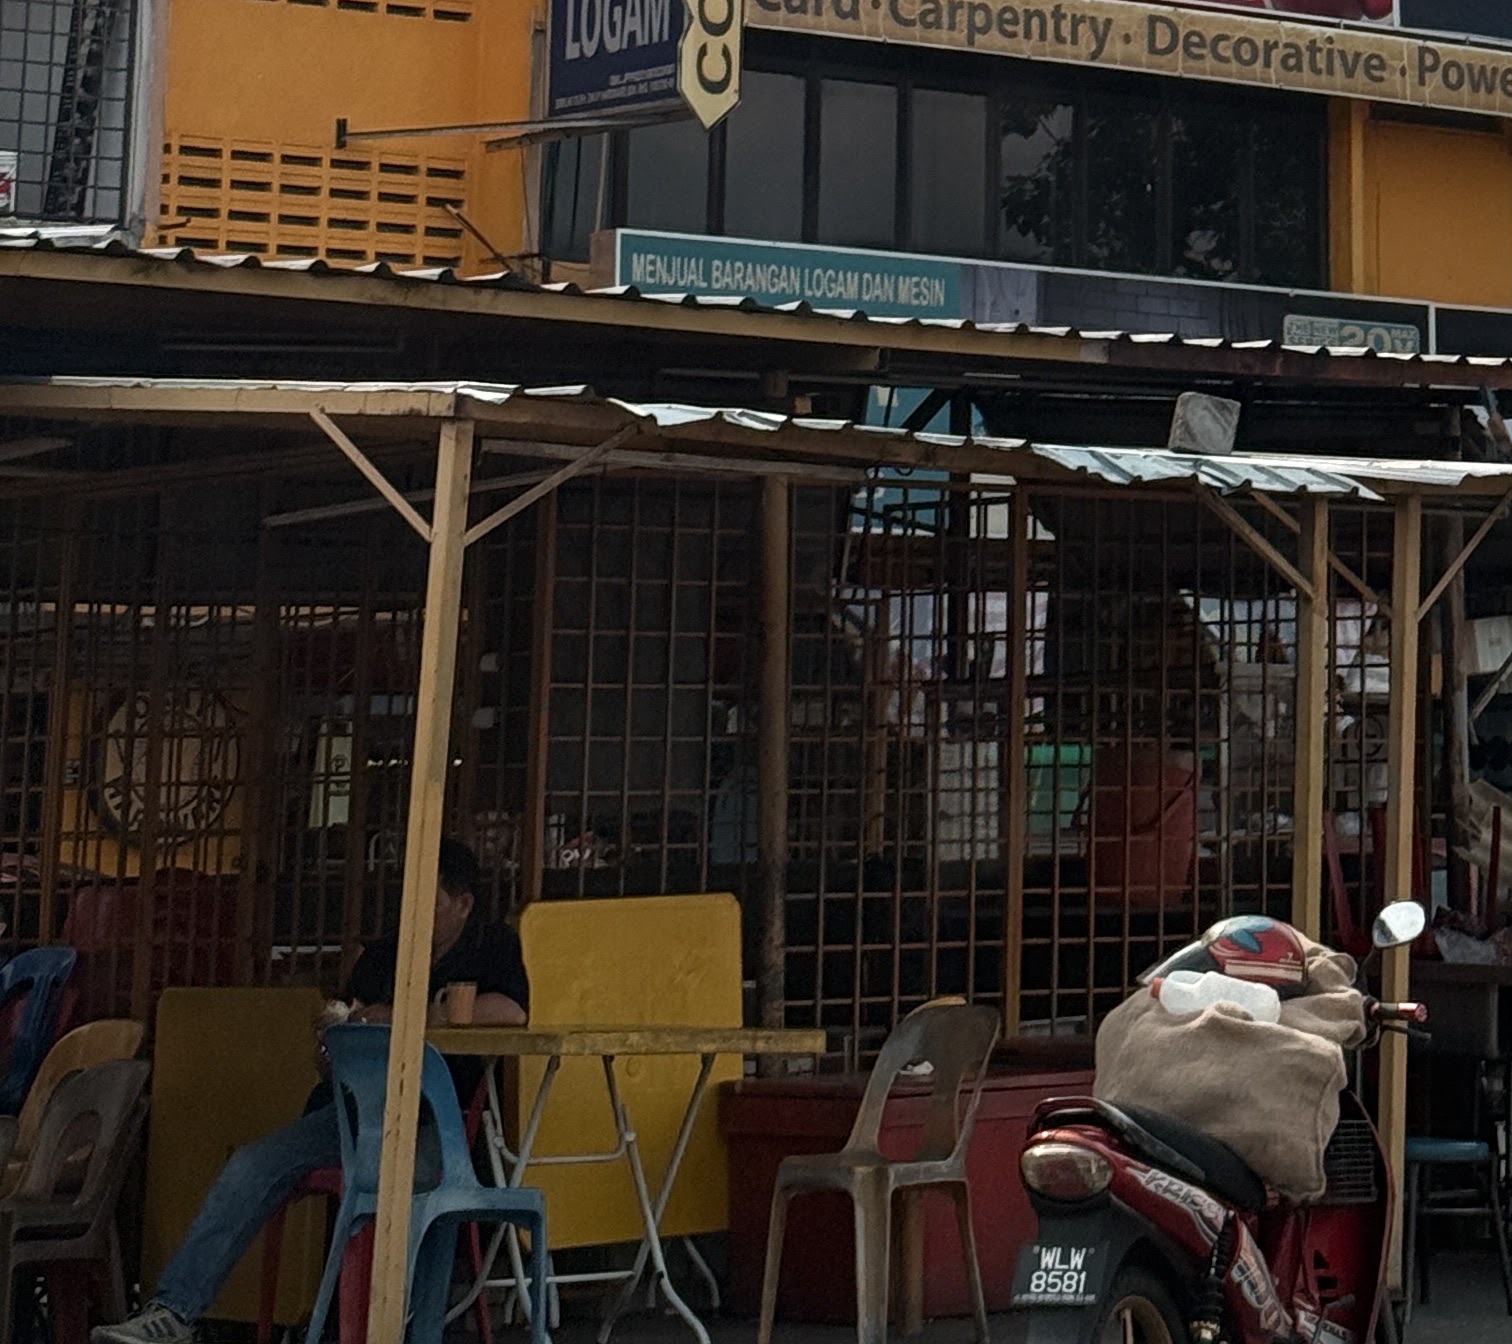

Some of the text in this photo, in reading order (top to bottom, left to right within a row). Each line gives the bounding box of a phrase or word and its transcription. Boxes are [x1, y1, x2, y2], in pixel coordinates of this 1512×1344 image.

[1147, 12, 1388, 84] Decorative
[631, 252, 946, 308] MENJUAL BARANGAN LOGAM DAN MESIN
[1040, 1246, 1087, 1270] WLW
[1029, 1270, 1087, 1293] 8581
